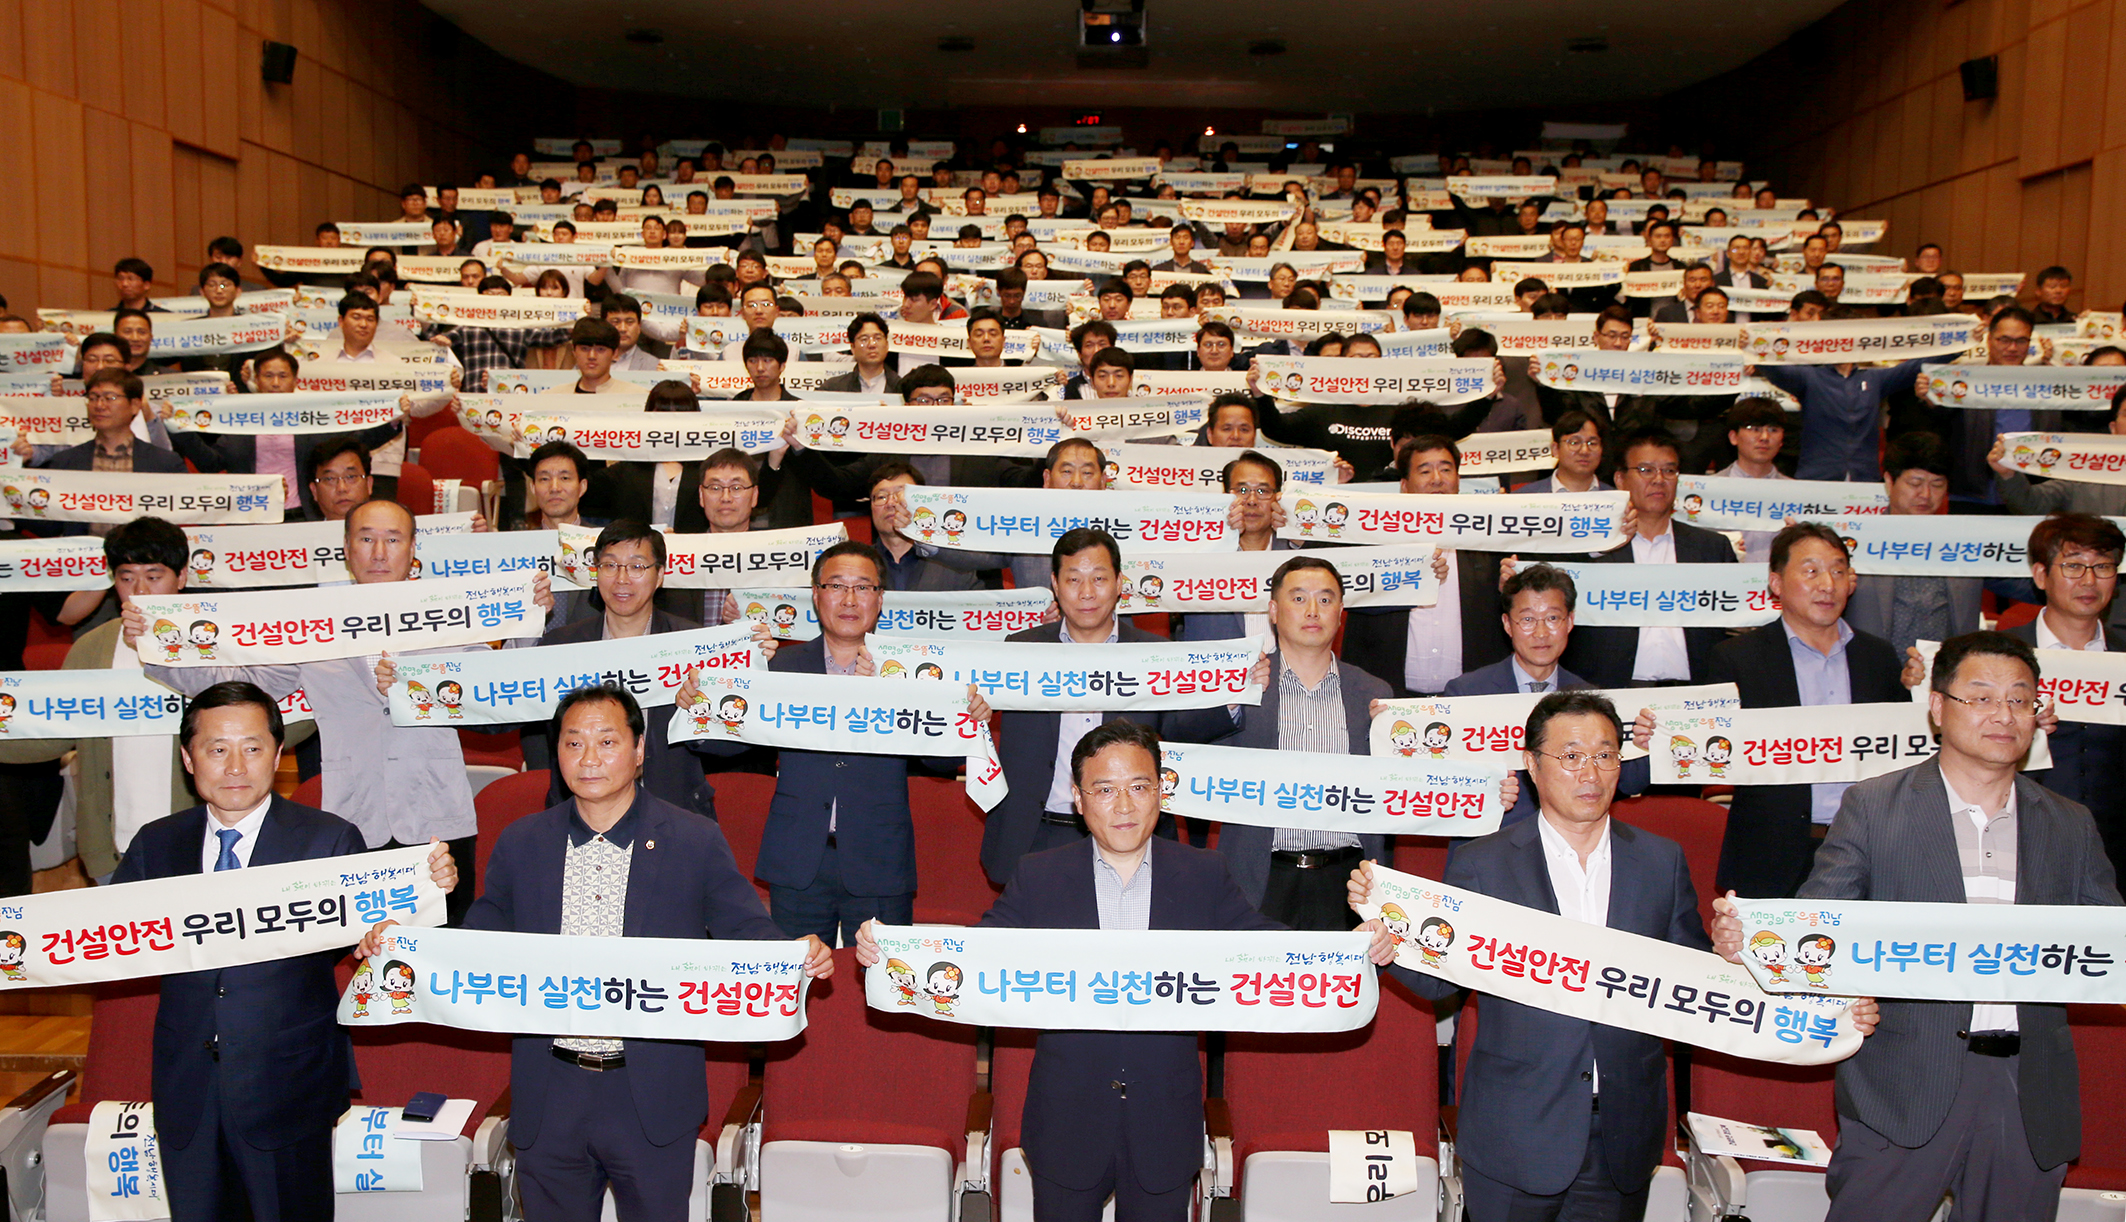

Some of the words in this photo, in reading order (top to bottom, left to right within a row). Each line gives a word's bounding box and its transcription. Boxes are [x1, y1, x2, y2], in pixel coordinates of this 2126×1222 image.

[454, 307, 497, 319] 건설안전
[231, 329, 280, 345] 건설안전
[1795, 338, 1854, 354] 건설안전
[1857, 334, 1886, 349] 우리
[1890, 333, 1935, 347] 모두의
[1939, 331, 1967, 345] 행복
[296, 378, 346, 392] 건설안전
[349, 380, 375, 392] 우리
[378, 378, 417, 392] 모두의
[419, 379, 445, 392] 행복
[1002, 381, 1028, 395] 우리
[1309, 377, 1369, 393] 건설안전
[1373, 378, 1403, 393] 우리
[1406, 377, 1451, 393] 모두의
[1455, 378, 1484, 393] 행복
[1584, 368, 1625, 382] 나부터
[1629, 369, 1681, 384] 실천하는
[1686, 371, 1740, 386] 건설안전
[1975, 384, 2018, 397] 나부터
[2023, 384, 2082, 399] 실천하는
[219, 412, 264, 427] 나부터
[269, 410, 330, 427] 실천하는
[334, 408, 394, 425] 건설안전
[1096, 414, 1124, 429] 우리
[1128, 411, 1170, 427] 모두의
[1174, 409, 1202, 425] 행복
[573, 429, 641, 448] 건설안전
[645, 431, 679, 448] 우리
[684, 430, 736, 448] 모두의
[740, 429, 775, 448] 행복
[856, 421, 928, 441] 건설안전
[930, 425, 966, 442] 우리
[970, 426, 1022, 443] 모두의
[1027, 427, 1061, 445] 행복
[1485, 449, 1511, 462] 우리
[1127, 466, 1194, 486] 건설안전
[59, 493, 133, 511] 건설안전
[138, 495, 173, 511] 우리
[179, 495, 231, 511] 모두의
[236, 494, 269, 511] 행복
[1710, 499, 1762, 515] 나부터
[976, 515, 1040, 538] 나부터
[1138, 518, 1225, 541] 건설안전
[1358, 507, 1444, 534] 건설안전
[1450, 513, 1493, 536] 우리
[1498, 515, 1564, 537] 모두의
[1569, 517, 1613, 539] 행복
[224, 548, 308, 572] 건설안전
[700, 551, 742, 574] 우리
[748, 549, 810, 573] 모두의
[1867, 541, 1933, 560] 나부터
[1939, 542, 2027, 562] 실천하는
[20, 555, 107, 578] 건설안전
[1172, 576, 1258, 601] 건설안전
[1380, 570, 1422, 591] 행복
[1586, 590, 1650, 611] 나부터
[1656, 591, 1739, 612] 실천하는
[231, 617, 336, 646] 건설안전
[341, 613, 392, 640] 우리
[398, 605, 470, 633] 모두의
[477, 600, 526, 622] 행복
[961, 608, 1046, 631] 건설안전
[473, 679, 546, 707] 나부터
[1037, 670, 1139, 697] 실천하는
[1146, 668, 1247, 695] 건설안전
[2039, 678, 2109, 706] 설안전
[29, 696, 105, 721] 나부터
[114, 694, 189, 719] 실천하
[760, 702, 836, 731] 나부터
[844, 706, 947, 737] 실천하는
[1744, 737, 1843, 767] 건설안전
[1850, 734, 1898, 761] 우리
[1190, 775, 1265, 806] 나부터
[1274, 782, 1375, 813] 실천하는
[1383, 788, 1485, 819] 건설안전
[42, 917, 175, 965] 건설안전
[182, 908, 246, 945] 우리
[254, 894, 347, 935] 모두의
[354, 884, 419, 924] 행복
[1851, 940, 1957, 973] 나부터
[1968, 943, 2114, 977] 실천하는
[430, 970, 527, 1006] 나부터
[538, 975, 668, 1013] 실천하는
[678, 980, 802, 1018] 건설안전
[978, 969, 1075, 1003] 나부터
[1088, 968, 1220, 1005] 실천하는
[1230, 971, 1362, 1008] 건설안전
[1466, 934, 1591, 992] 건설안전
[1596, 965, 1661, 1008] 우리
[1663, 980, 1765, 1033] 모두의
[1774, 1006, 1839, 1048] 행복
[108, 1145, 140, 1198] 행복
